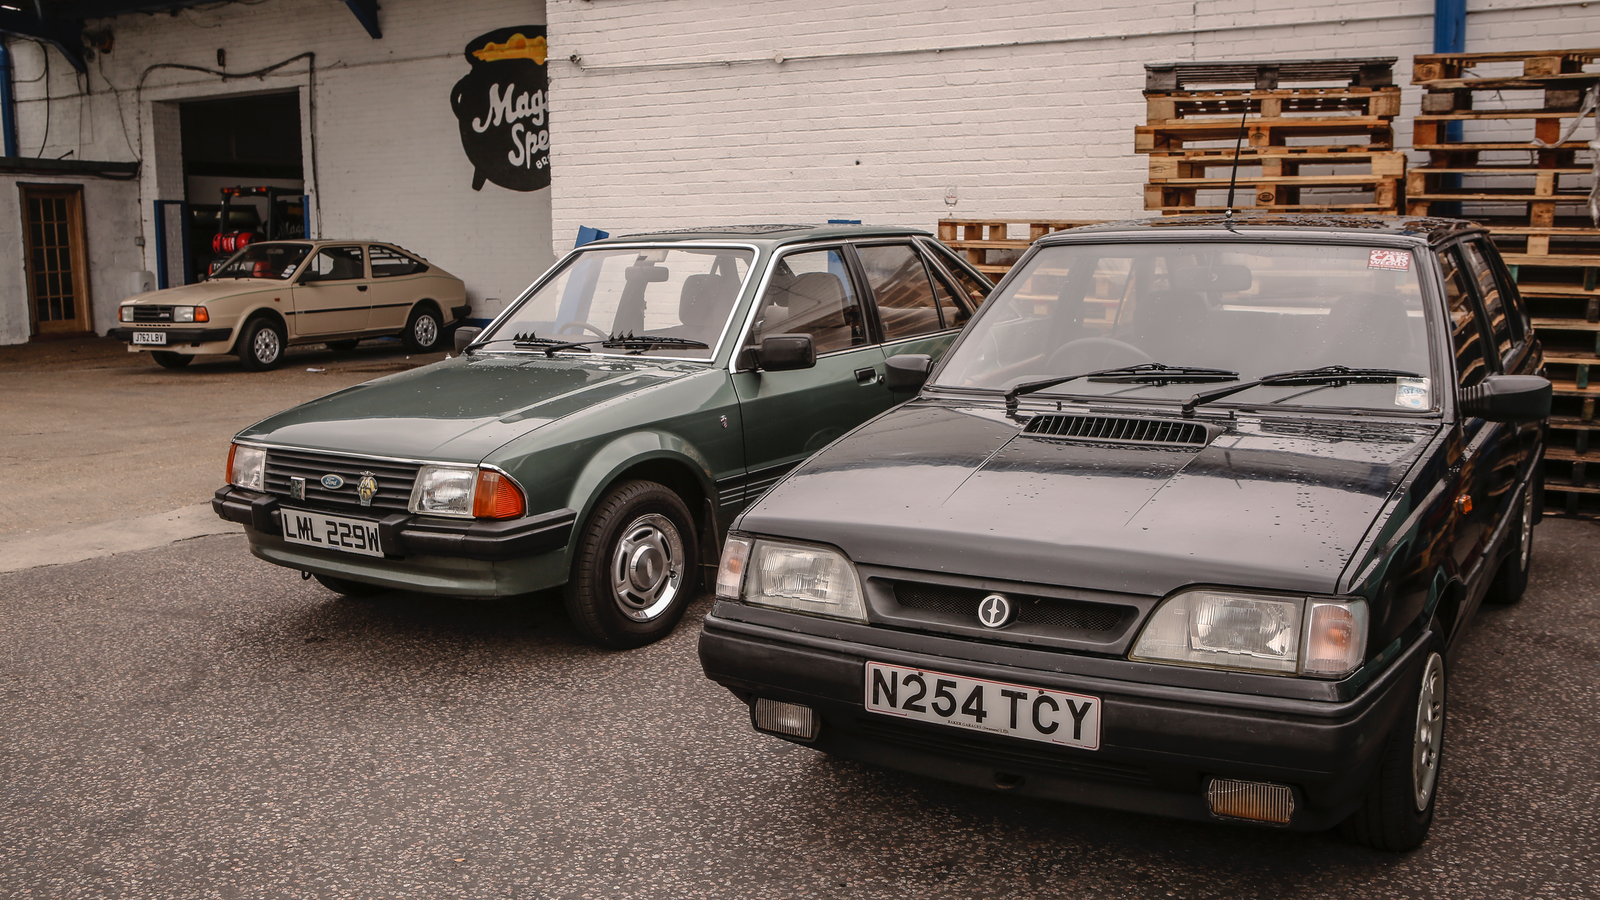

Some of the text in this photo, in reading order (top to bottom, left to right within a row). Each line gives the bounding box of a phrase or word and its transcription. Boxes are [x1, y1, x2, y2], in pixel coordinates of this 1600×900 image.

[535, 154, 550, 169] BR
[1370, 254, 1408, 263] CAR
[213, 262, 246, 271] TOOTA
[136, 333, 163, 342] J762 LBV
[325, 477, 338, 486] Ford
[284, 514, 380, 553] LML 229W
[872, 668, 1093, 741] N254 TCY
